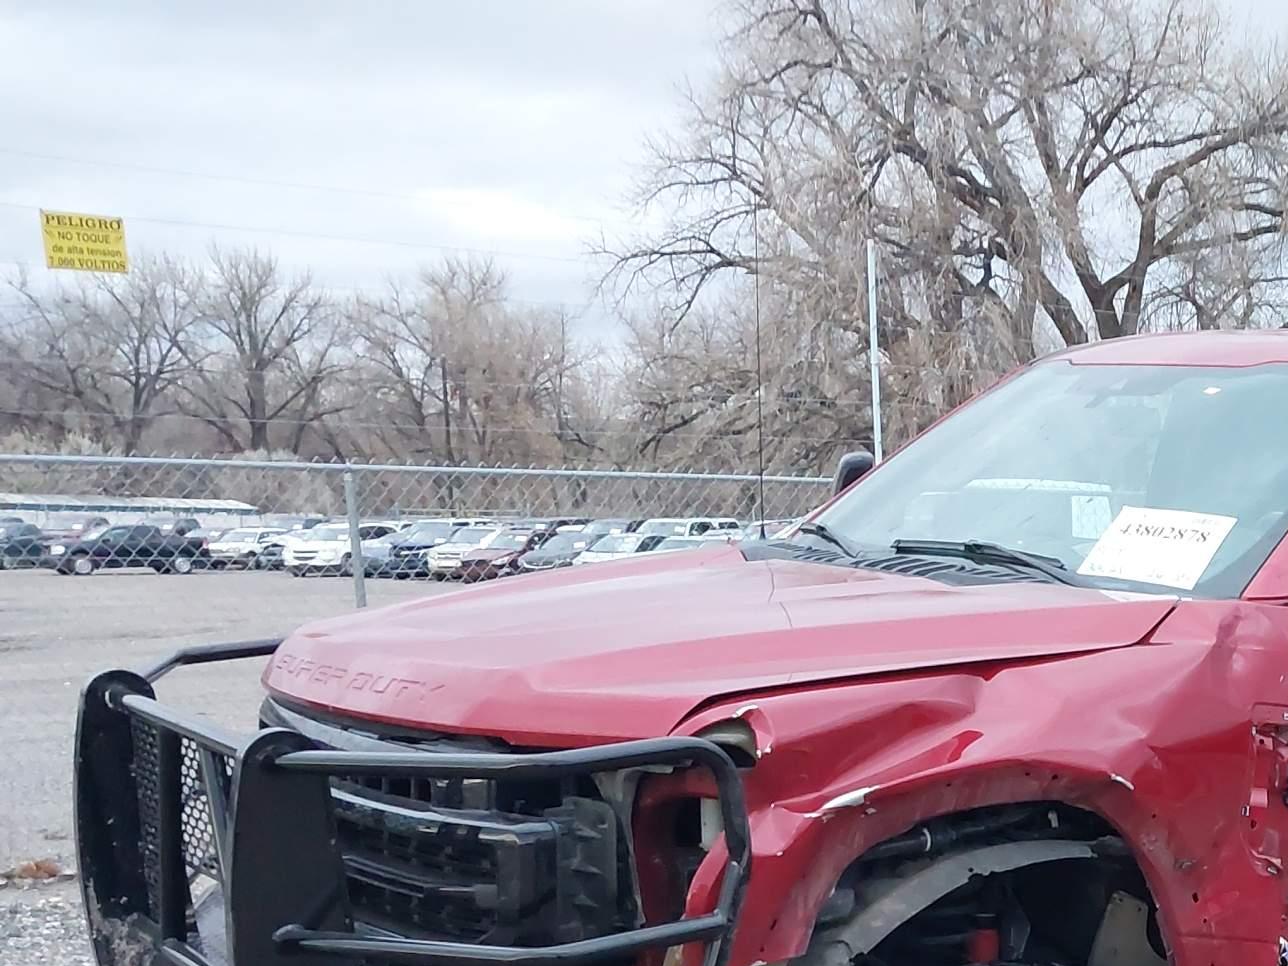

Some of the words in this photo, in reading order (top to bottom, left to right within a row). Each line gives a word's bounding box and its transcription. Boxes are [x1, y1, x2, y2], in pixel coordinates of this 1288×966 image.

[45, 214, 121, 230] PELIGRO
[57, 231, 73, 241] NO
[75, 231, 111, 244] TOQUE
[77, 257, 126, 271] VOLTIOS
[1120, 523, 1211, 543] 43802878
[275, 653, 348, 685] SUPER
[347, 671, 447, 702] DUTY
